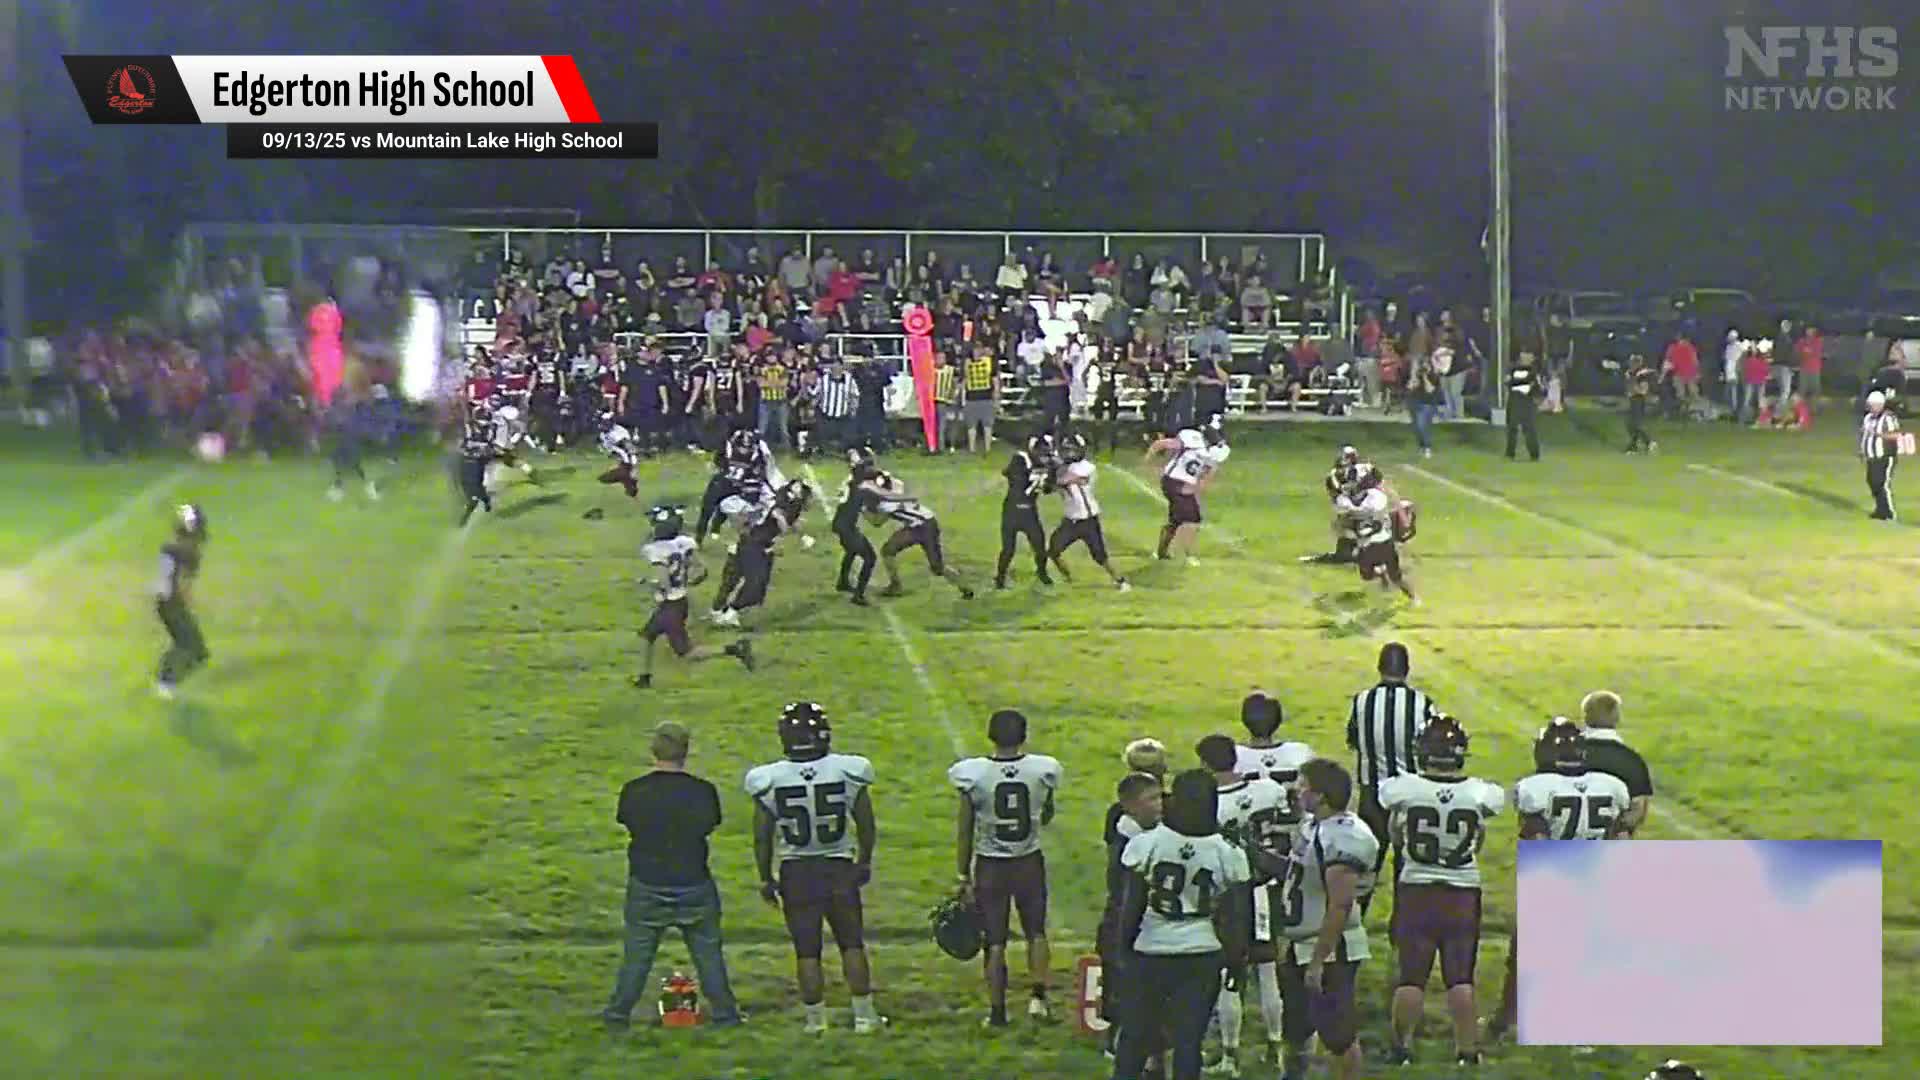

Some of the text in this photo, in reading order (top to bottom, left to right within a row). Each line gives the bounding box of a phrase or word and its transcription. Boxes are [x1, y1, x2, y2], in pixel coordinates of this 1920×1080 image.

[774, 783, 846, 847] 55
[994, 781, 1031, 842] 9
[1407, 806, 1479, 868] 62
[1550, 795, 1615, 841] 75
[1150, 861, 1214, 921] 81
